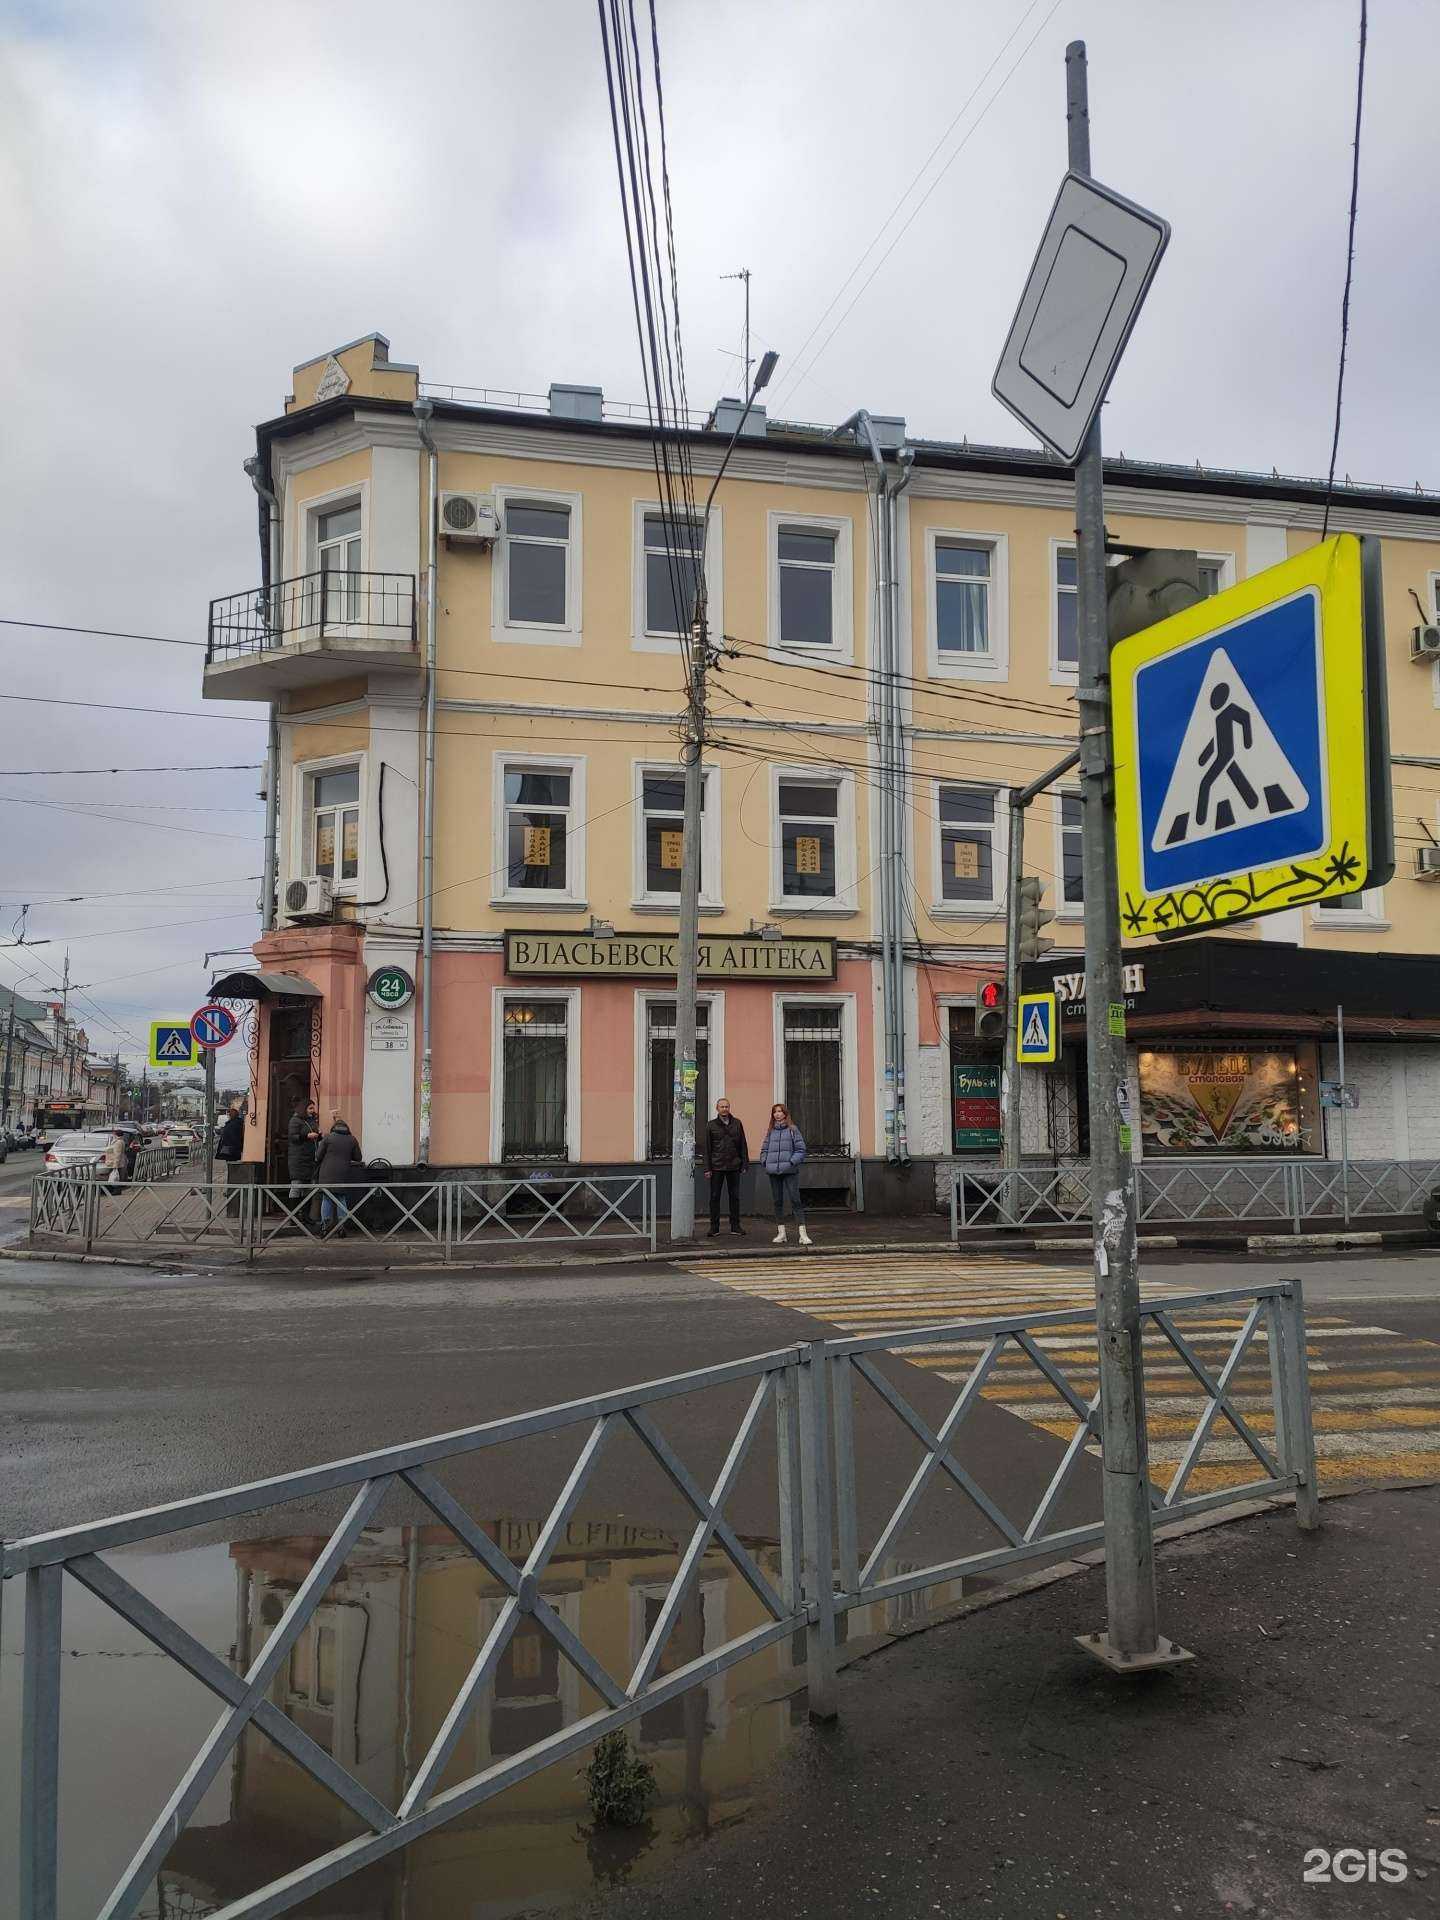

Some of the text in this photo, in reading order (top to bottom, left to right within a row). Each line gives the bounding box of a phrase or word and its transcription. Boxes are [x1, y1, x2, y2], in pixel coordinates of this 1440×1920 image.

[513, 941, 827, 970] ВЛАСЬЕВСКЯ АПТЕКА
[380, 979, 400, 992] 24
[1053, 963, 1146, 1002] БУН
[385, 1041, 394, 1049] 38
[1178, 1054, 1254, 1075] БУЛЬОН
